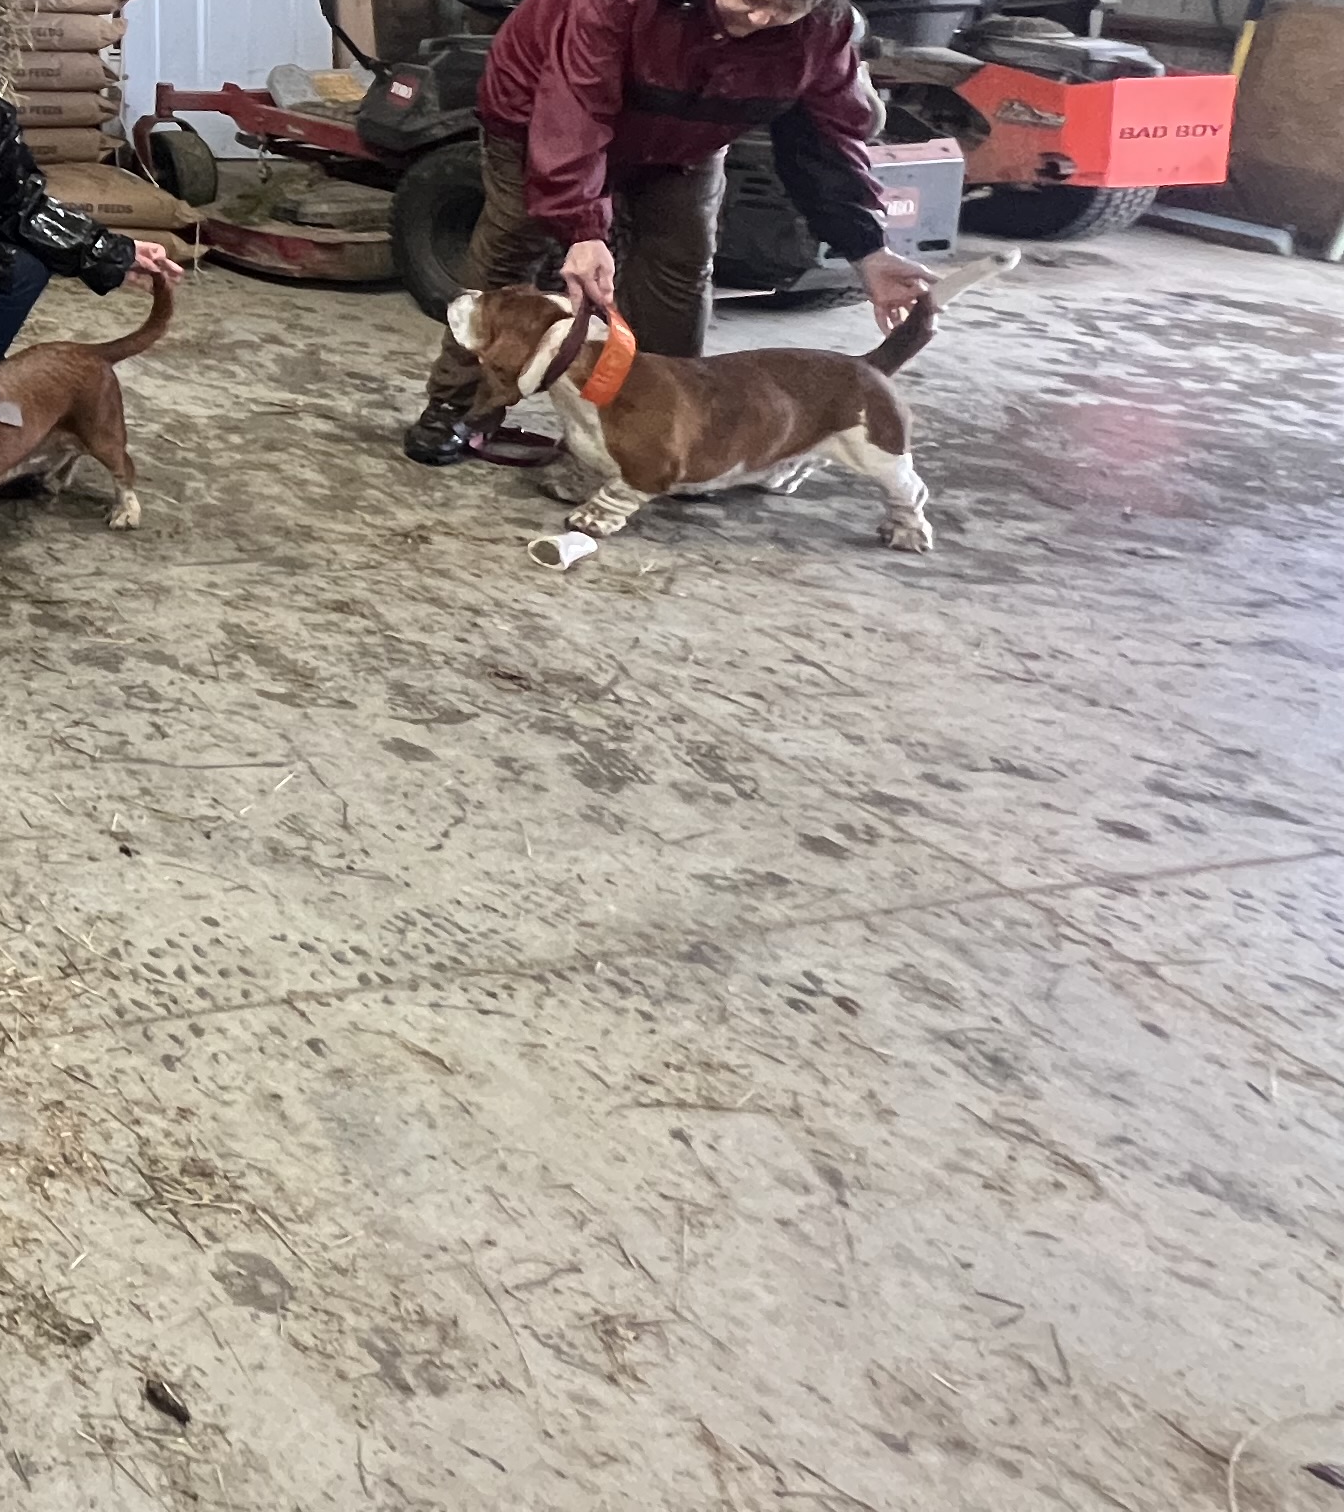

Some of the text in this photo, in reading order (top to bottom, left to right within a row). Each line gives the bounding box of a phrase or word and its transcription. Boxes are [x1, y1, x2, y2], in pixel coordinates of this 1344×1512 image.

[1119, 123, 1224, 139] BAD BOY
[97, 203, 133, 214] FEEDS
